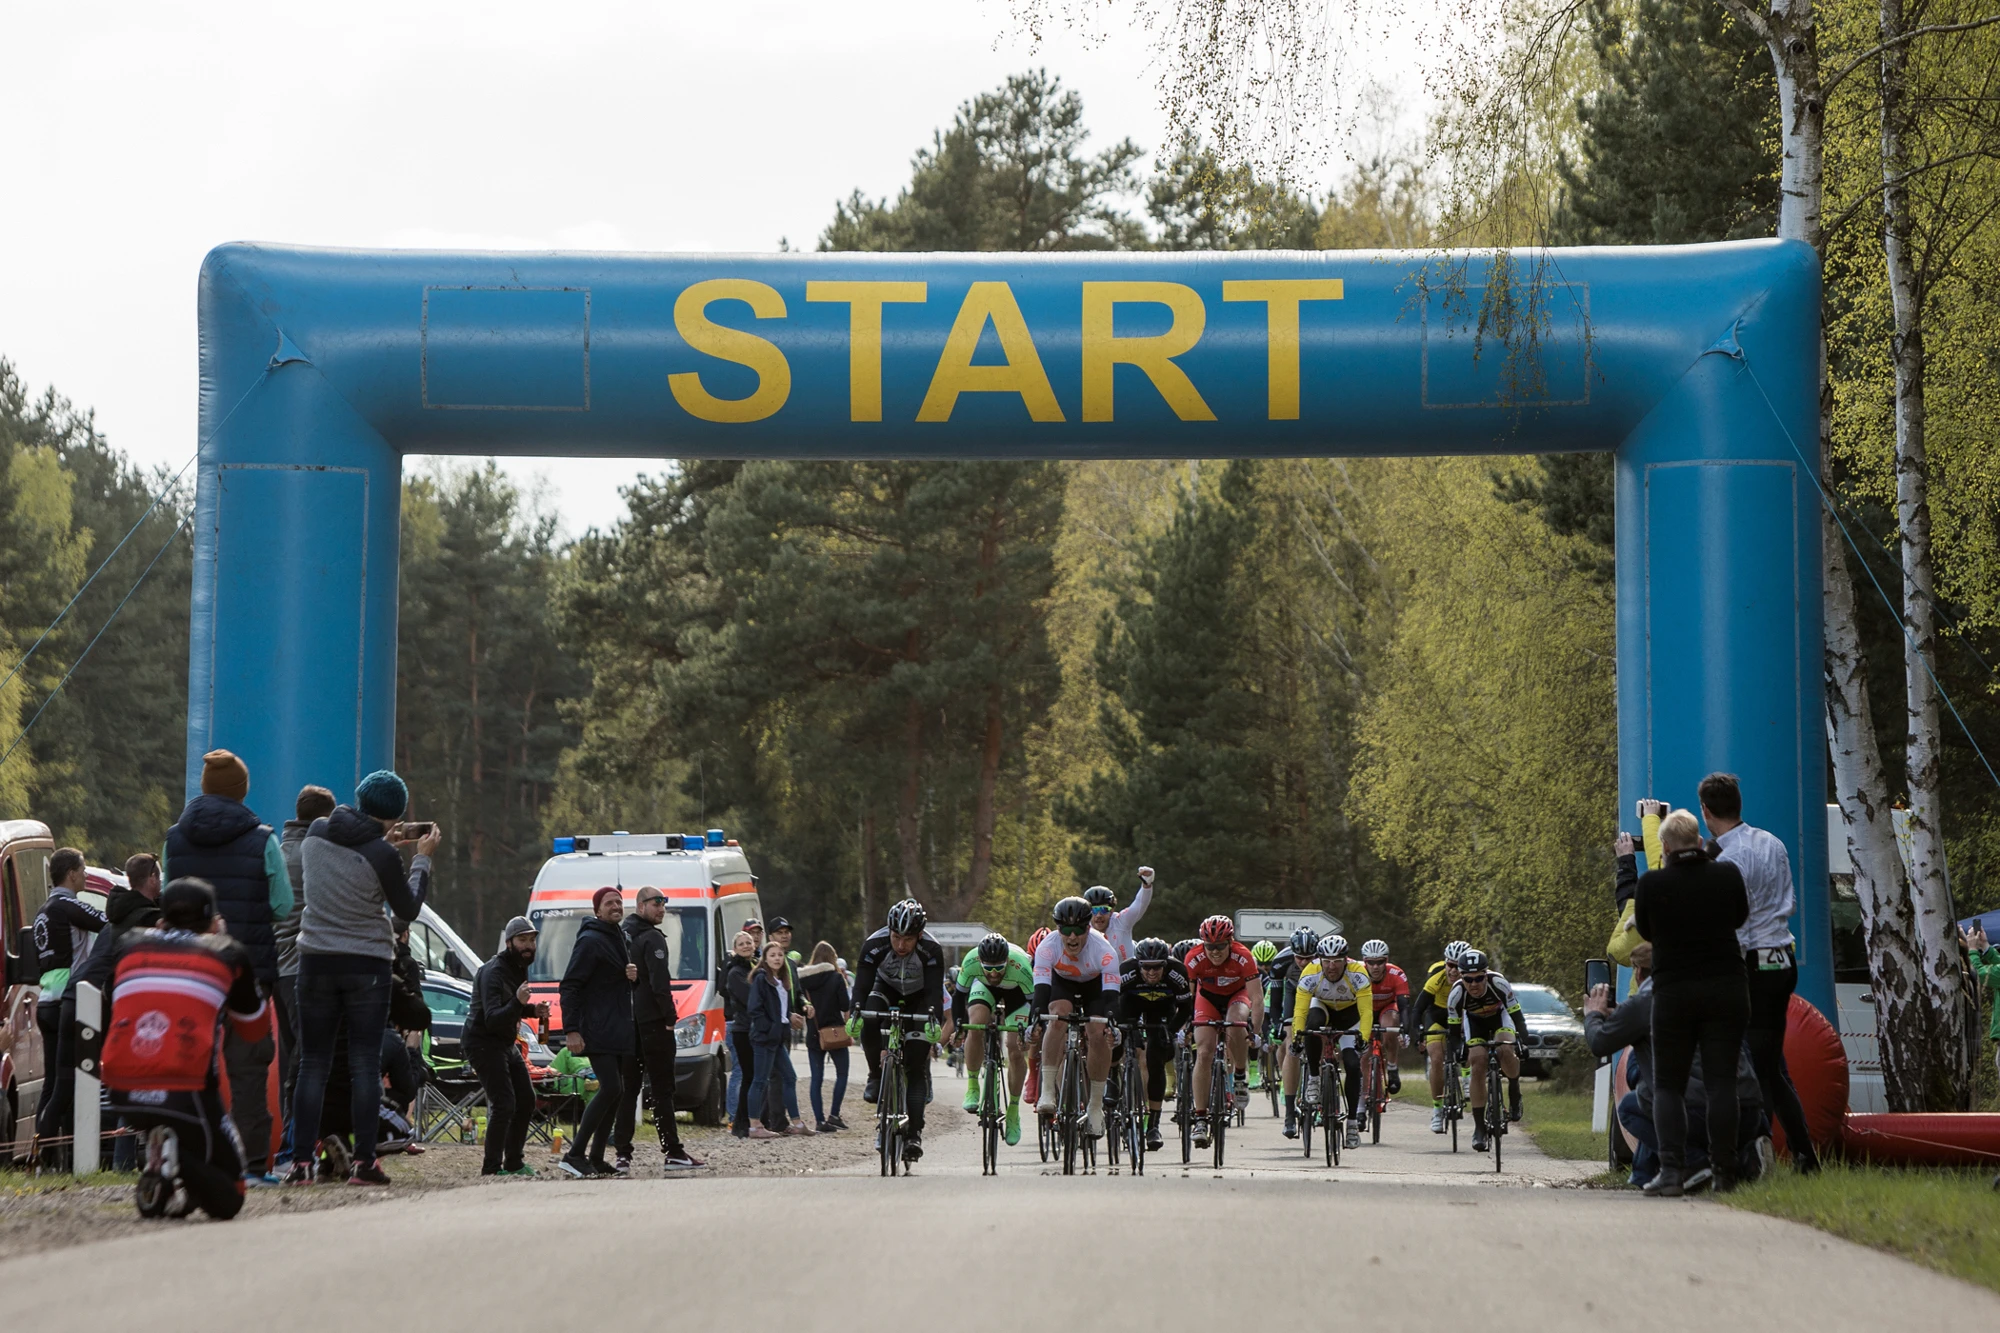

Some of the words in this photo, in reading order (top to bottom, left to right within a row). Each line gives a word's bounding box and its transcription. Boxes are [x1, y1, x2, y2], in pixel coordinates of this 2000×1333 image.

[667, 278, 1344, 423] START
[1264, 921, 1284, 931] OKA
[1120, 969, 1137, 984] MC
[1168, 969, 1188, 989] BMC
